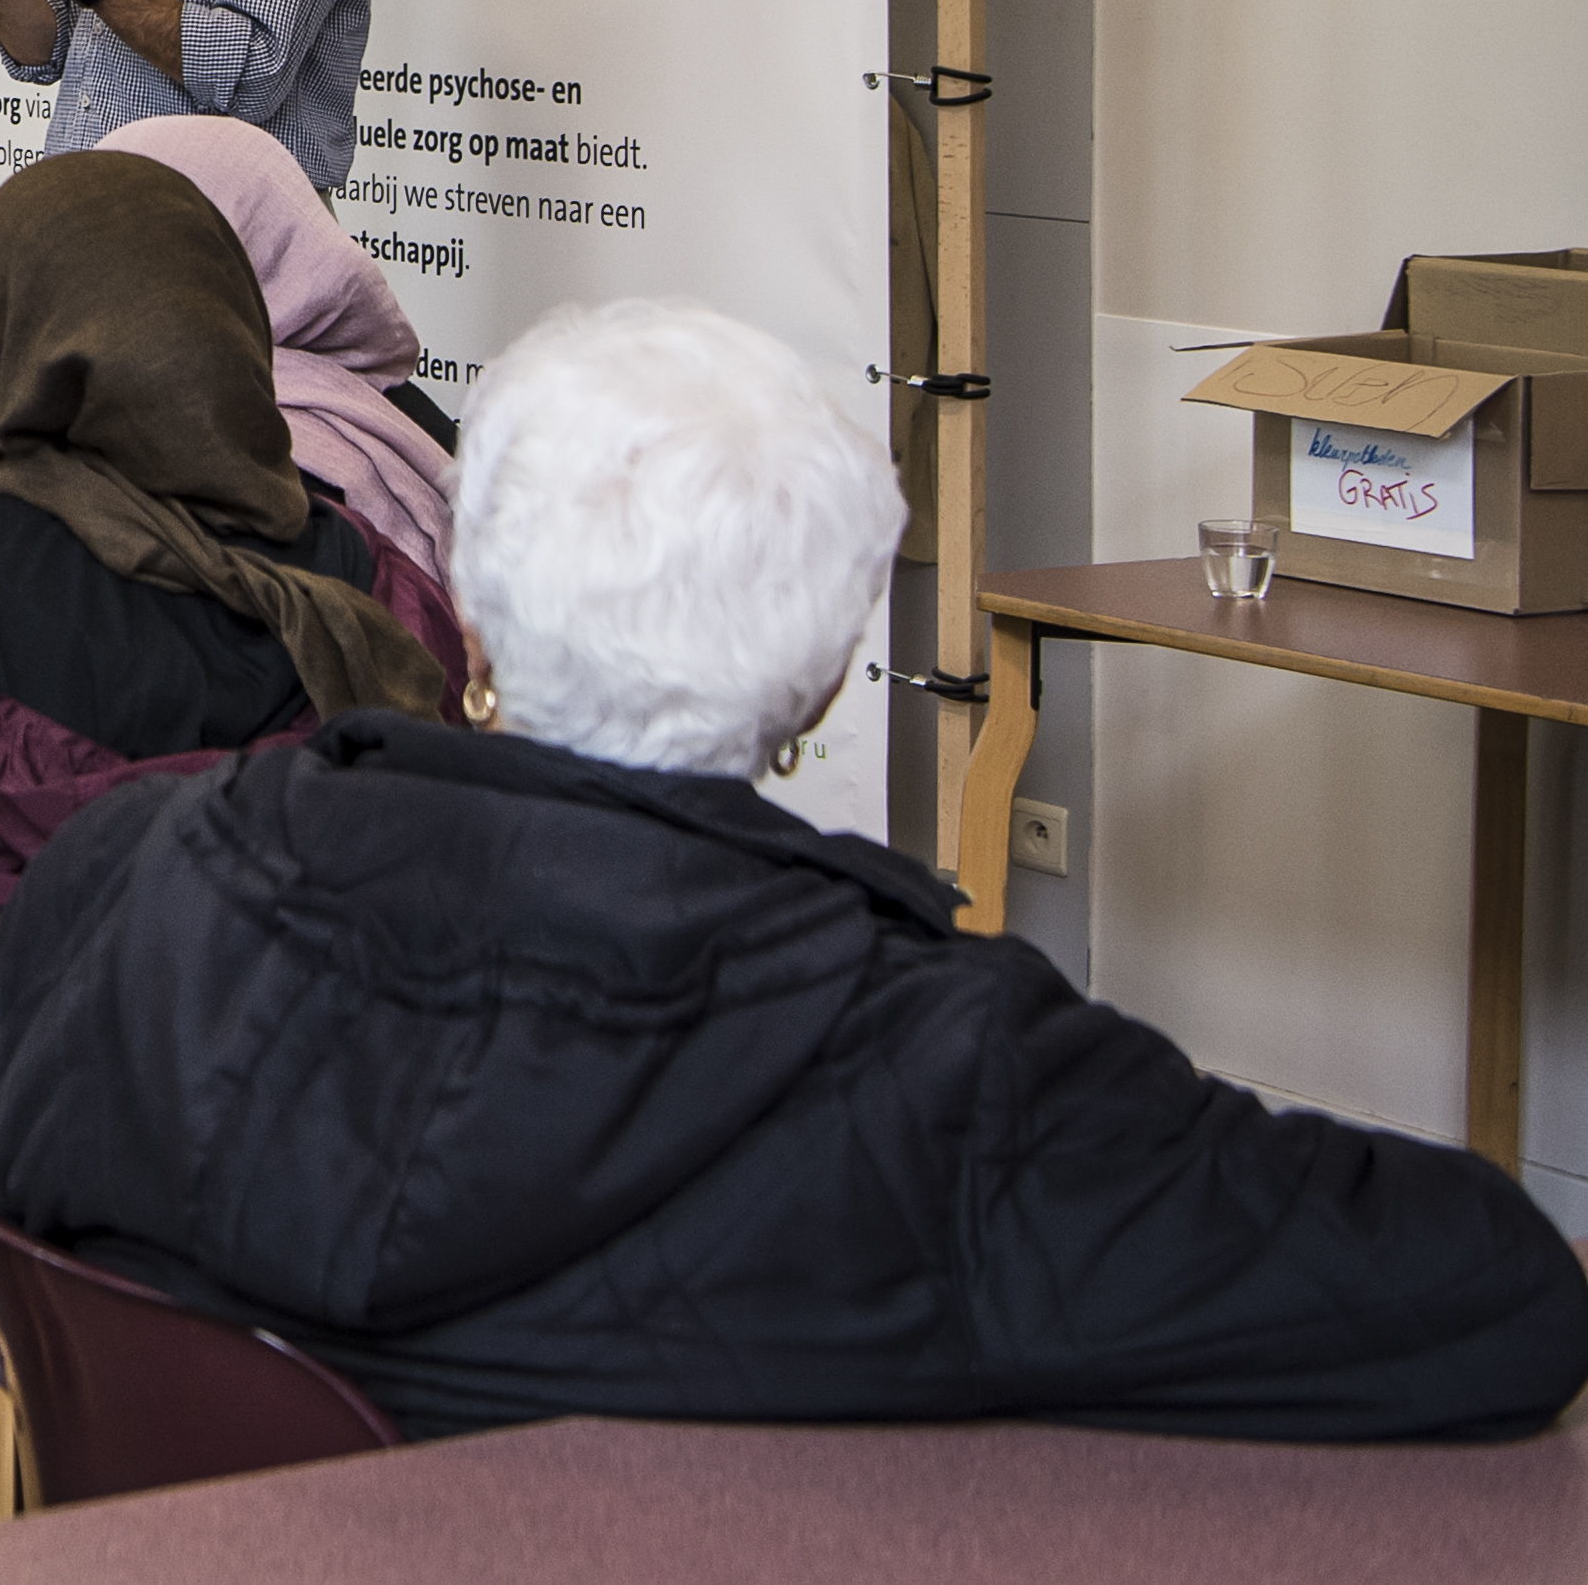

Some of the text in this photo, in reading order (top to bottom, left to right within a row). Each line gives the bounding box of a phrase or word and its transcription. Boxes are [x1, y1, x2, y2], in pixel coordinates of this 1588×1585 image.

[26, 93, 51, 119] via
[429, 68, 545, 106] psychose-
[552, 80, 582, 105] en
[413, 129, 462, 163] zorg
[469, 134, 498, 165] op
[506, 134, 569, 163] maat
[576, 133, 648, 170] biedt.
[329, 174, 645, 229] aarbij we streven naar een
